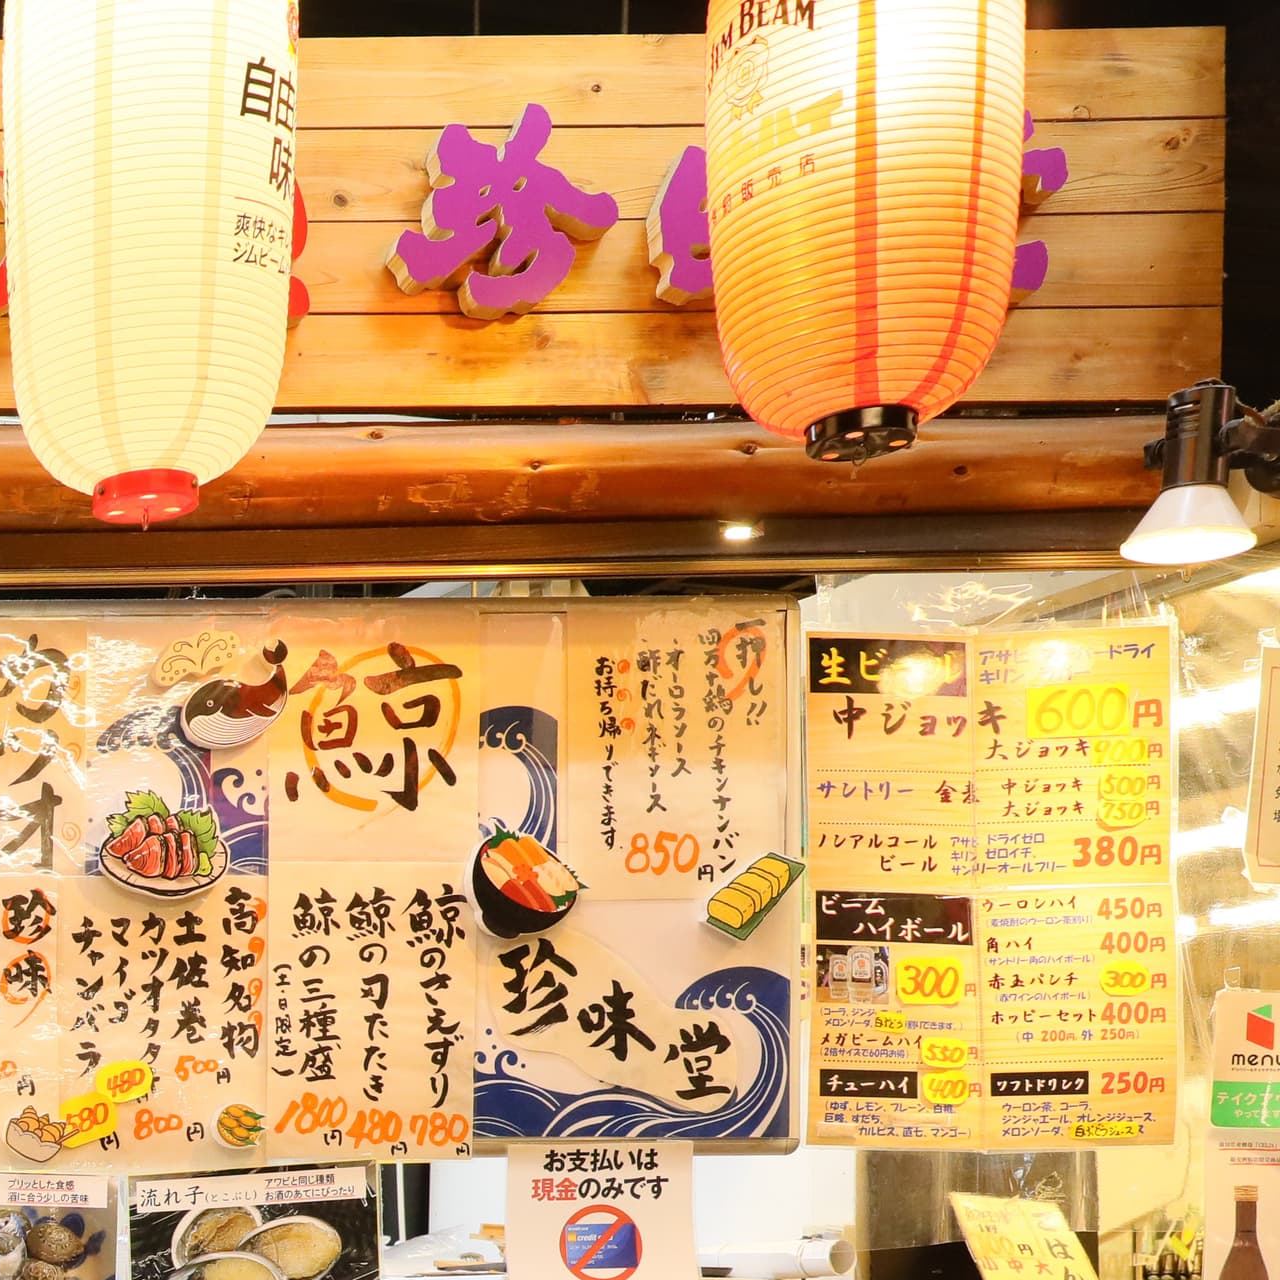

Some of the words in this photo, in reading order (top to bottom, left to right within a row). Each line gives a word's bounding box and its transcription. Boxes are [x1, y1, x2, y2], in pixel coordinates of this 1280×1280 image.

[285, 642, 463, 811] 鯨
[832, 695, 1008, 740] 中ジョッキ
[698, 628, 740, 874] 四万十鶏のチキンナンバン
[985, 737, 1091, 761] 大ジョッキ
[816, 780, 914, 801] サントリー
[1001, 777, 1084, 793] 中ジョッキ
[1002, 801, 1085, 818] 大ジョッキ
[818, 833, 938, 850] ノンアルコール
[986, 833, 1046, 846] ドライゼロ
[1072, 835, 1162, 867] 380円
[880, 855, 938, 873] ビール
[820, 894, 886, 916] ビーム
[981, 895, 1078, 913] ウーロンハイ
[1097, 897, 1163, 921] 450円
[853, 917, 970, 944] ハイボール
[986, 936, 1034, 953] 角ハイ
[1100, 931, 1166, 954] 400円
[2, 888, 57, 998] 珍味
[170, 911, 210, 1045] 土佐巻
[221, 886, 260, 1060] 高知名物
[291, 887, 341, 1082] 鯨の三種盛
[989, 972, 1080, 990] 赤玉パンチ
[70, 917, 104, 1079] チャンバラ
[401, 884, 467, 1109] 鯨のさえずり
[498, 938, 733, 1101] 珍味堂
[991, 1008, 1097, 1026] ホッピーセット
[1100, 1001, 1167, 1025] 400円
[826, 1074, 909, 1094] チューハイ
[996, 1077, 1086, 1092] ソフトドリンク
[1101, 1071, 1165, 1094] 250円
[543, 1147, 659, 1174] お支払いは
[7, 1178, 74, 1191] プリッとした食感
[264, 1173, 336, 1188] アワビと同じ種類
[264, 1184, 357, 1200] お酒のあてにぴったり
[531, 1174, 670, 1201] 現金のみです
[7, 1191, 90, 1205] 酒に合う少しの苦味
[140, 1185, 204, 1208] 流れ子
